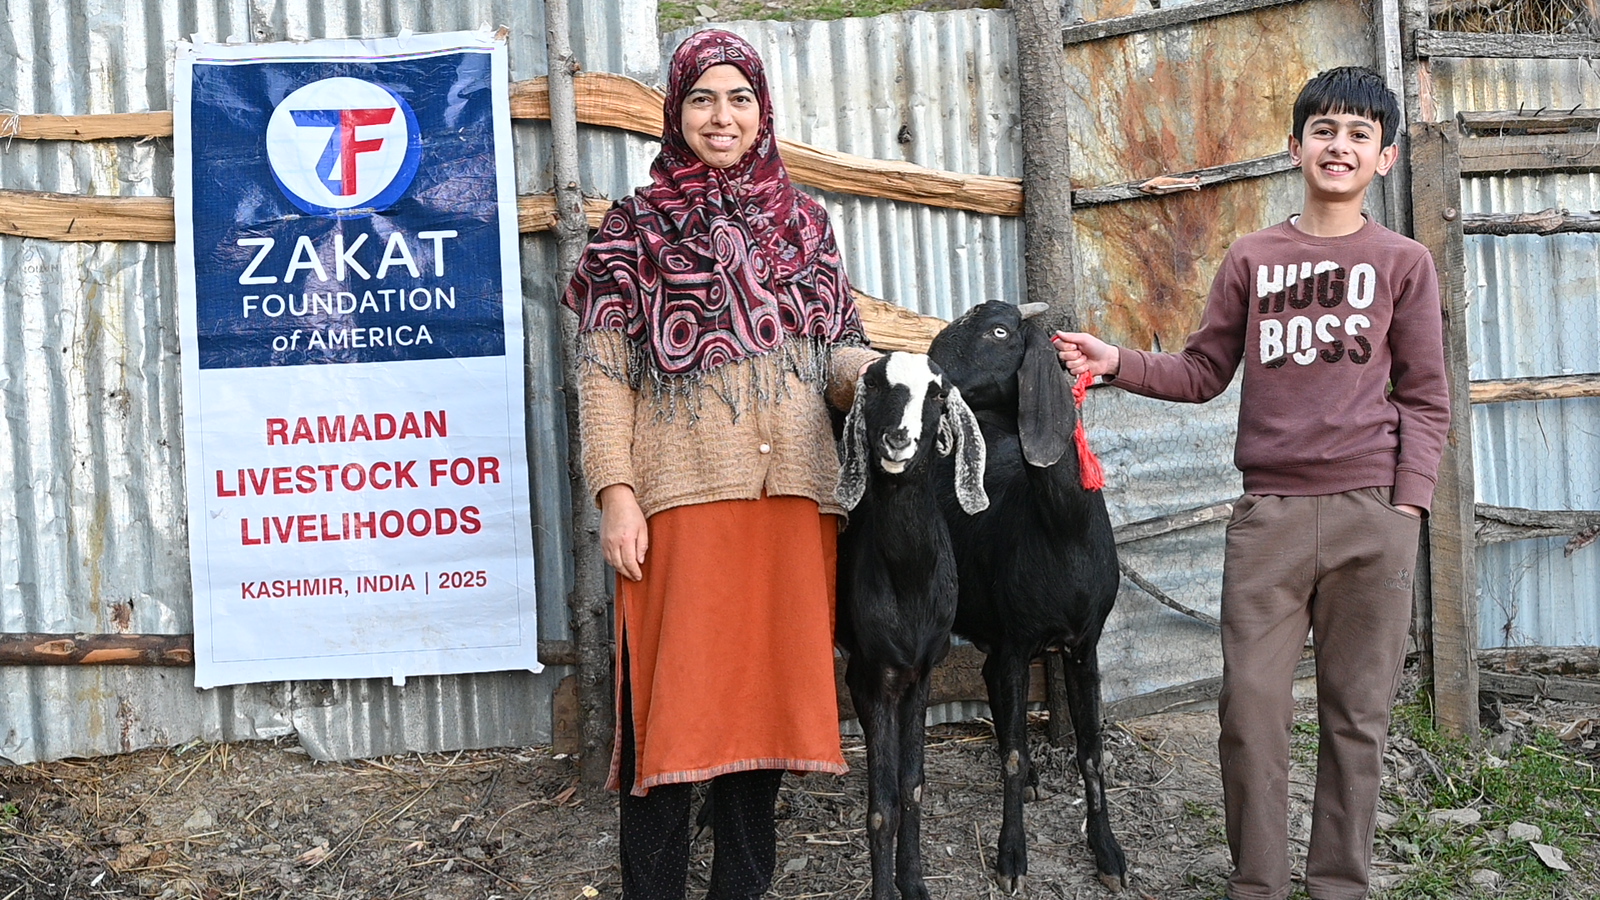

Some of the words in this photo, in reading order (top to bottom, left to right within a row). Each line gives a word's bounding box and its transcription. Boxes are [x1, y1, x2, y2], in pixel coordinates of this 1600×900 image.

[238, 230, 458, 286] ZAKAT
[243, 286, 456, 318] FOUNDATION
[1256, 260, 1377, 314] HUGO
[272, 329, 301, 352] of
[307, 324, 433, 350] AMERICA
[1259, 314, 1373, 368] BOSS
[266, 410, 447, 446] RAMADAN
[216, 460, 418, 497] LIVESTOCK
[429, 456, 501, 487] FOR
[240, 506, 482, 545] LIVELIHOODS
[241, 577, 350, 599] KASHMIR,
[356, 574, 415, 594] INDIA
[438, 570, 487, 590] 2025
